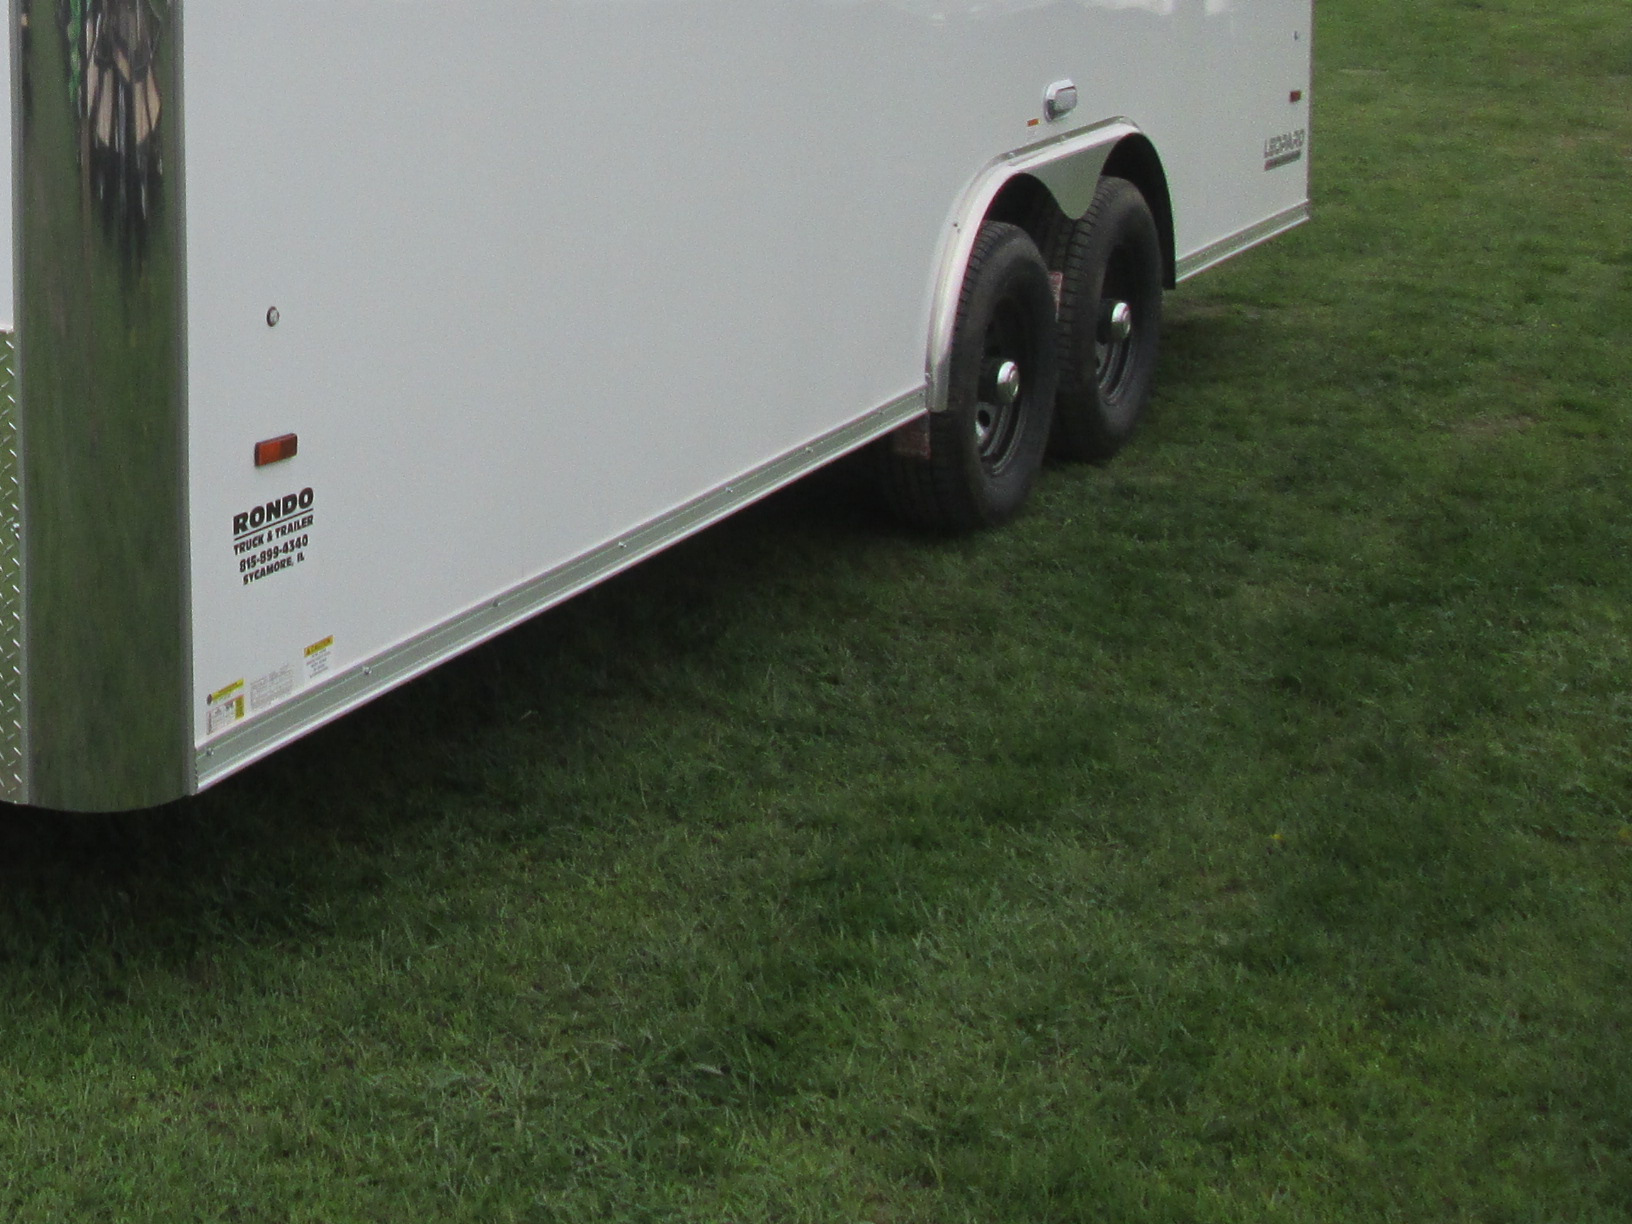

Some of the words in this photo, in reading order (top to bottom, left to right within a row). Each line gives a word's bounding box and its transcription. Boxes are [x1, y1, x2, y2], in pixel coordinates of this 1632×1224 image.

[233, 487, 314, 535] RONDO
[234, 534, 264, 555] TRUCK
[267, 530, 273, 542] &
[275, 515, 314, 538] TRAILER
[239, 534, 309, 573] 815-899-4340
[297, 552, 305, 563] IL
